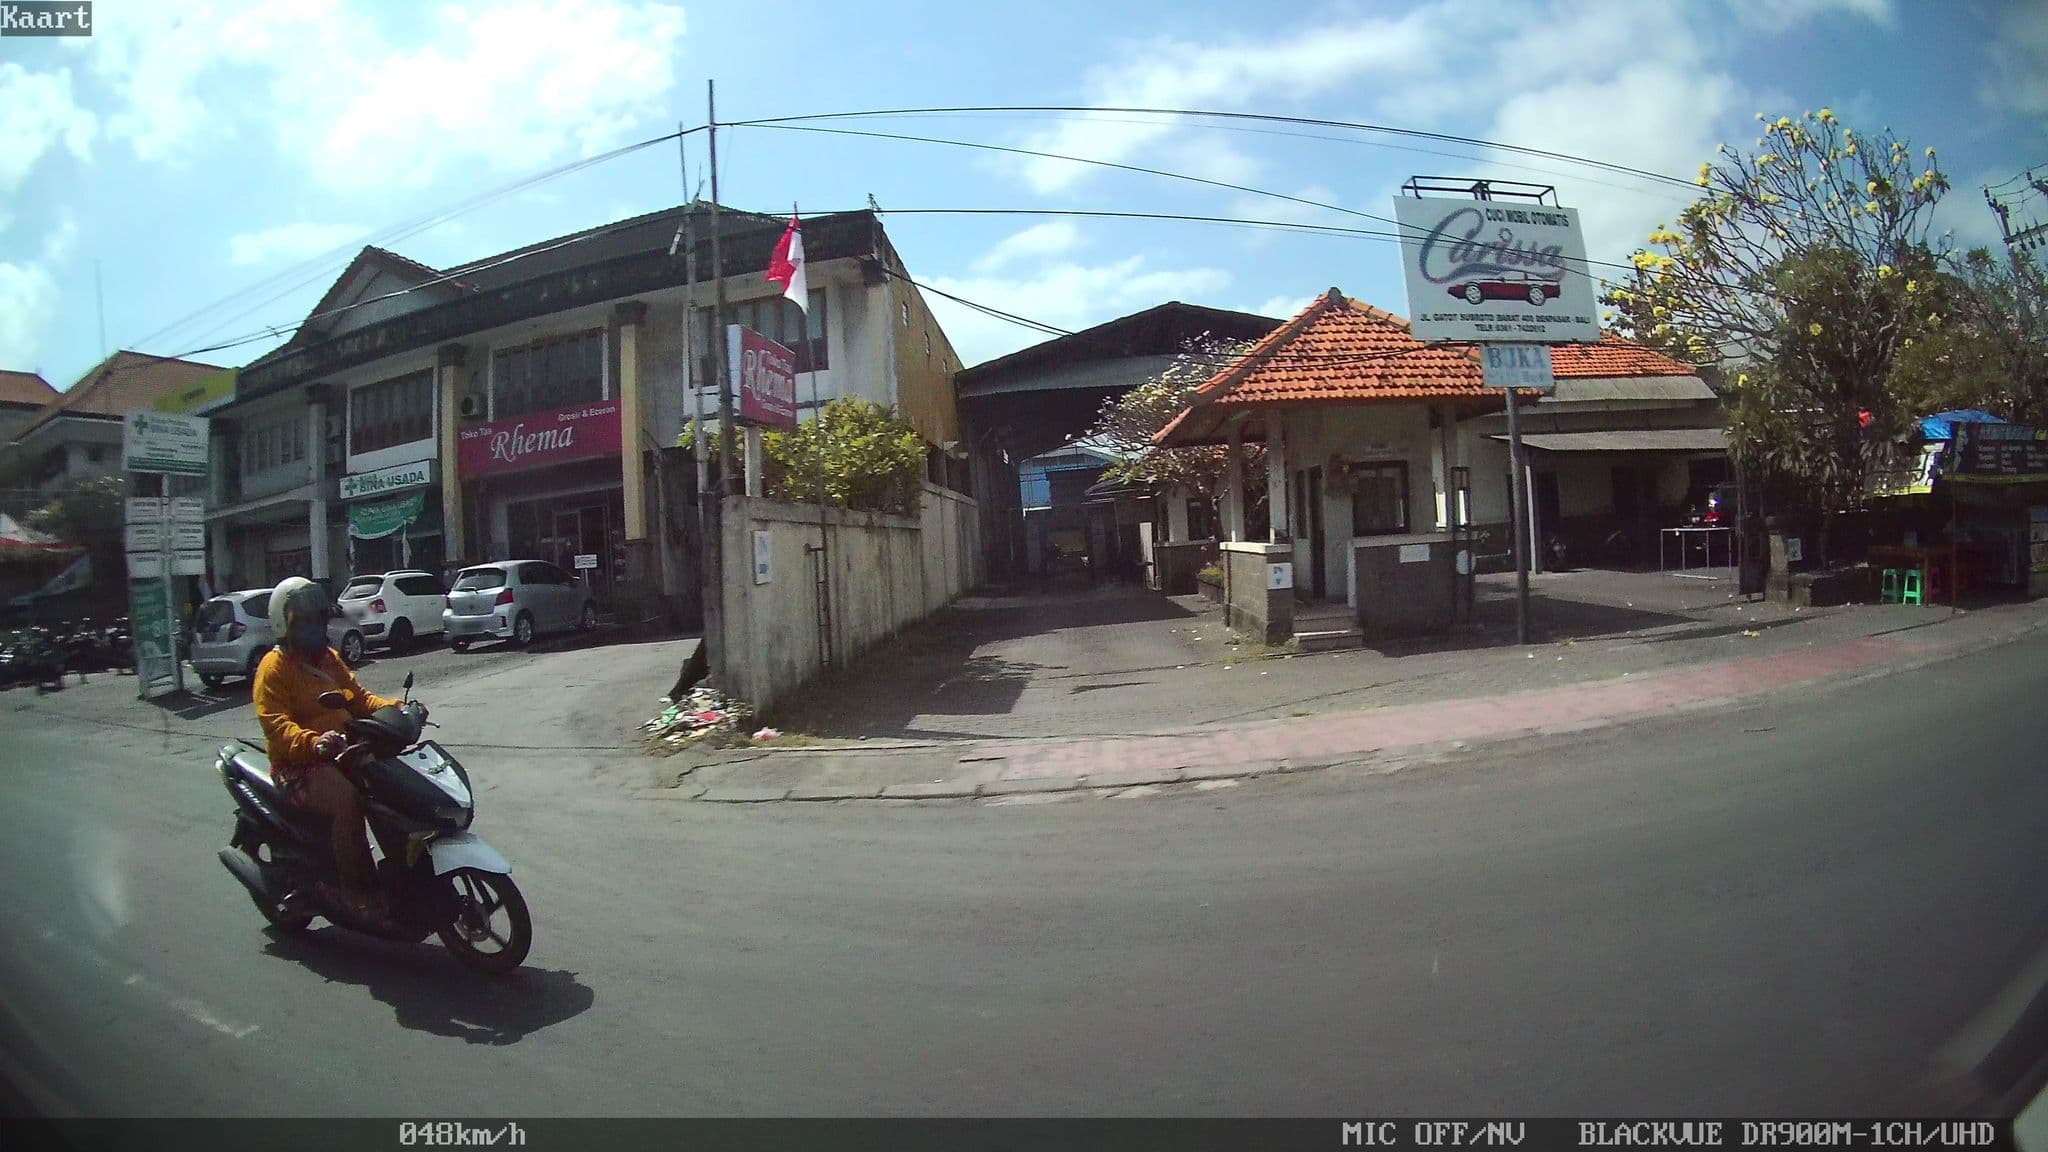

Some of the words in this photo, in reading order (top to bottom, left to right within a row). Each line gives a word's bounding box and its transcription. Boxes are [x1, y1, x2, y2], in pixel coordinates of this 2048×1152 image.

[1485, 208, 1505, 221] CUCI
[1505, 210, 1531, 224] MOBIL
[1531, 212, 1570, 227] OTOMATIS
[490, 423, 574, 463] Rhema
[386, 470, 425, 487] USADA
